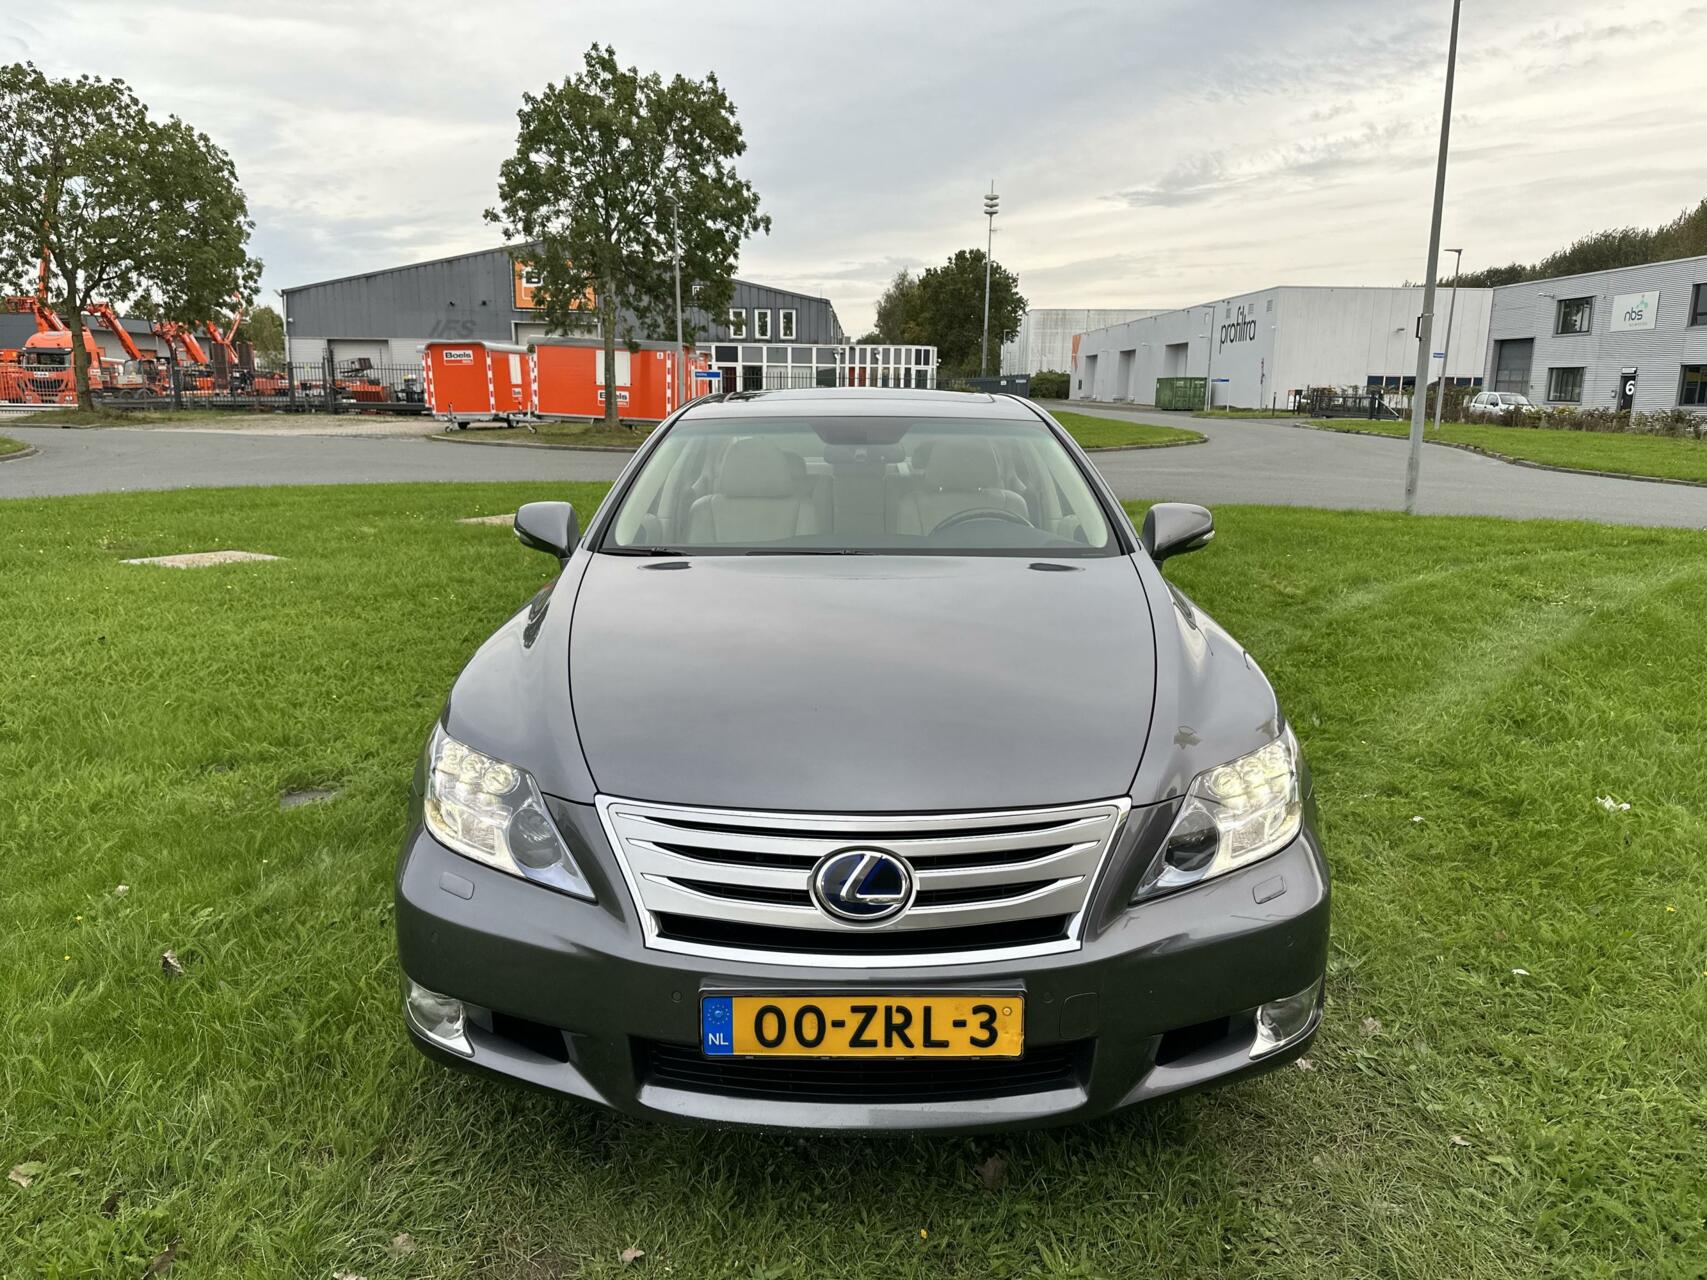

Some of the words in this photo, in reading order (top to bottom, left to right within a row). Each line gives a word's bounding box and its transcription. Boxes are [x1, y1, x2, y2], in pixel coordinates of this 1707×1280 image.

[1623, 307, 1643, 322] nbs
[1218, 305, 1257, 354] profiltra
[1625, 380, 1635, 395] 6
[753, 1005, 999, 1049] 00-ZRL-3
[708, 1033, 729, 1046] NL
